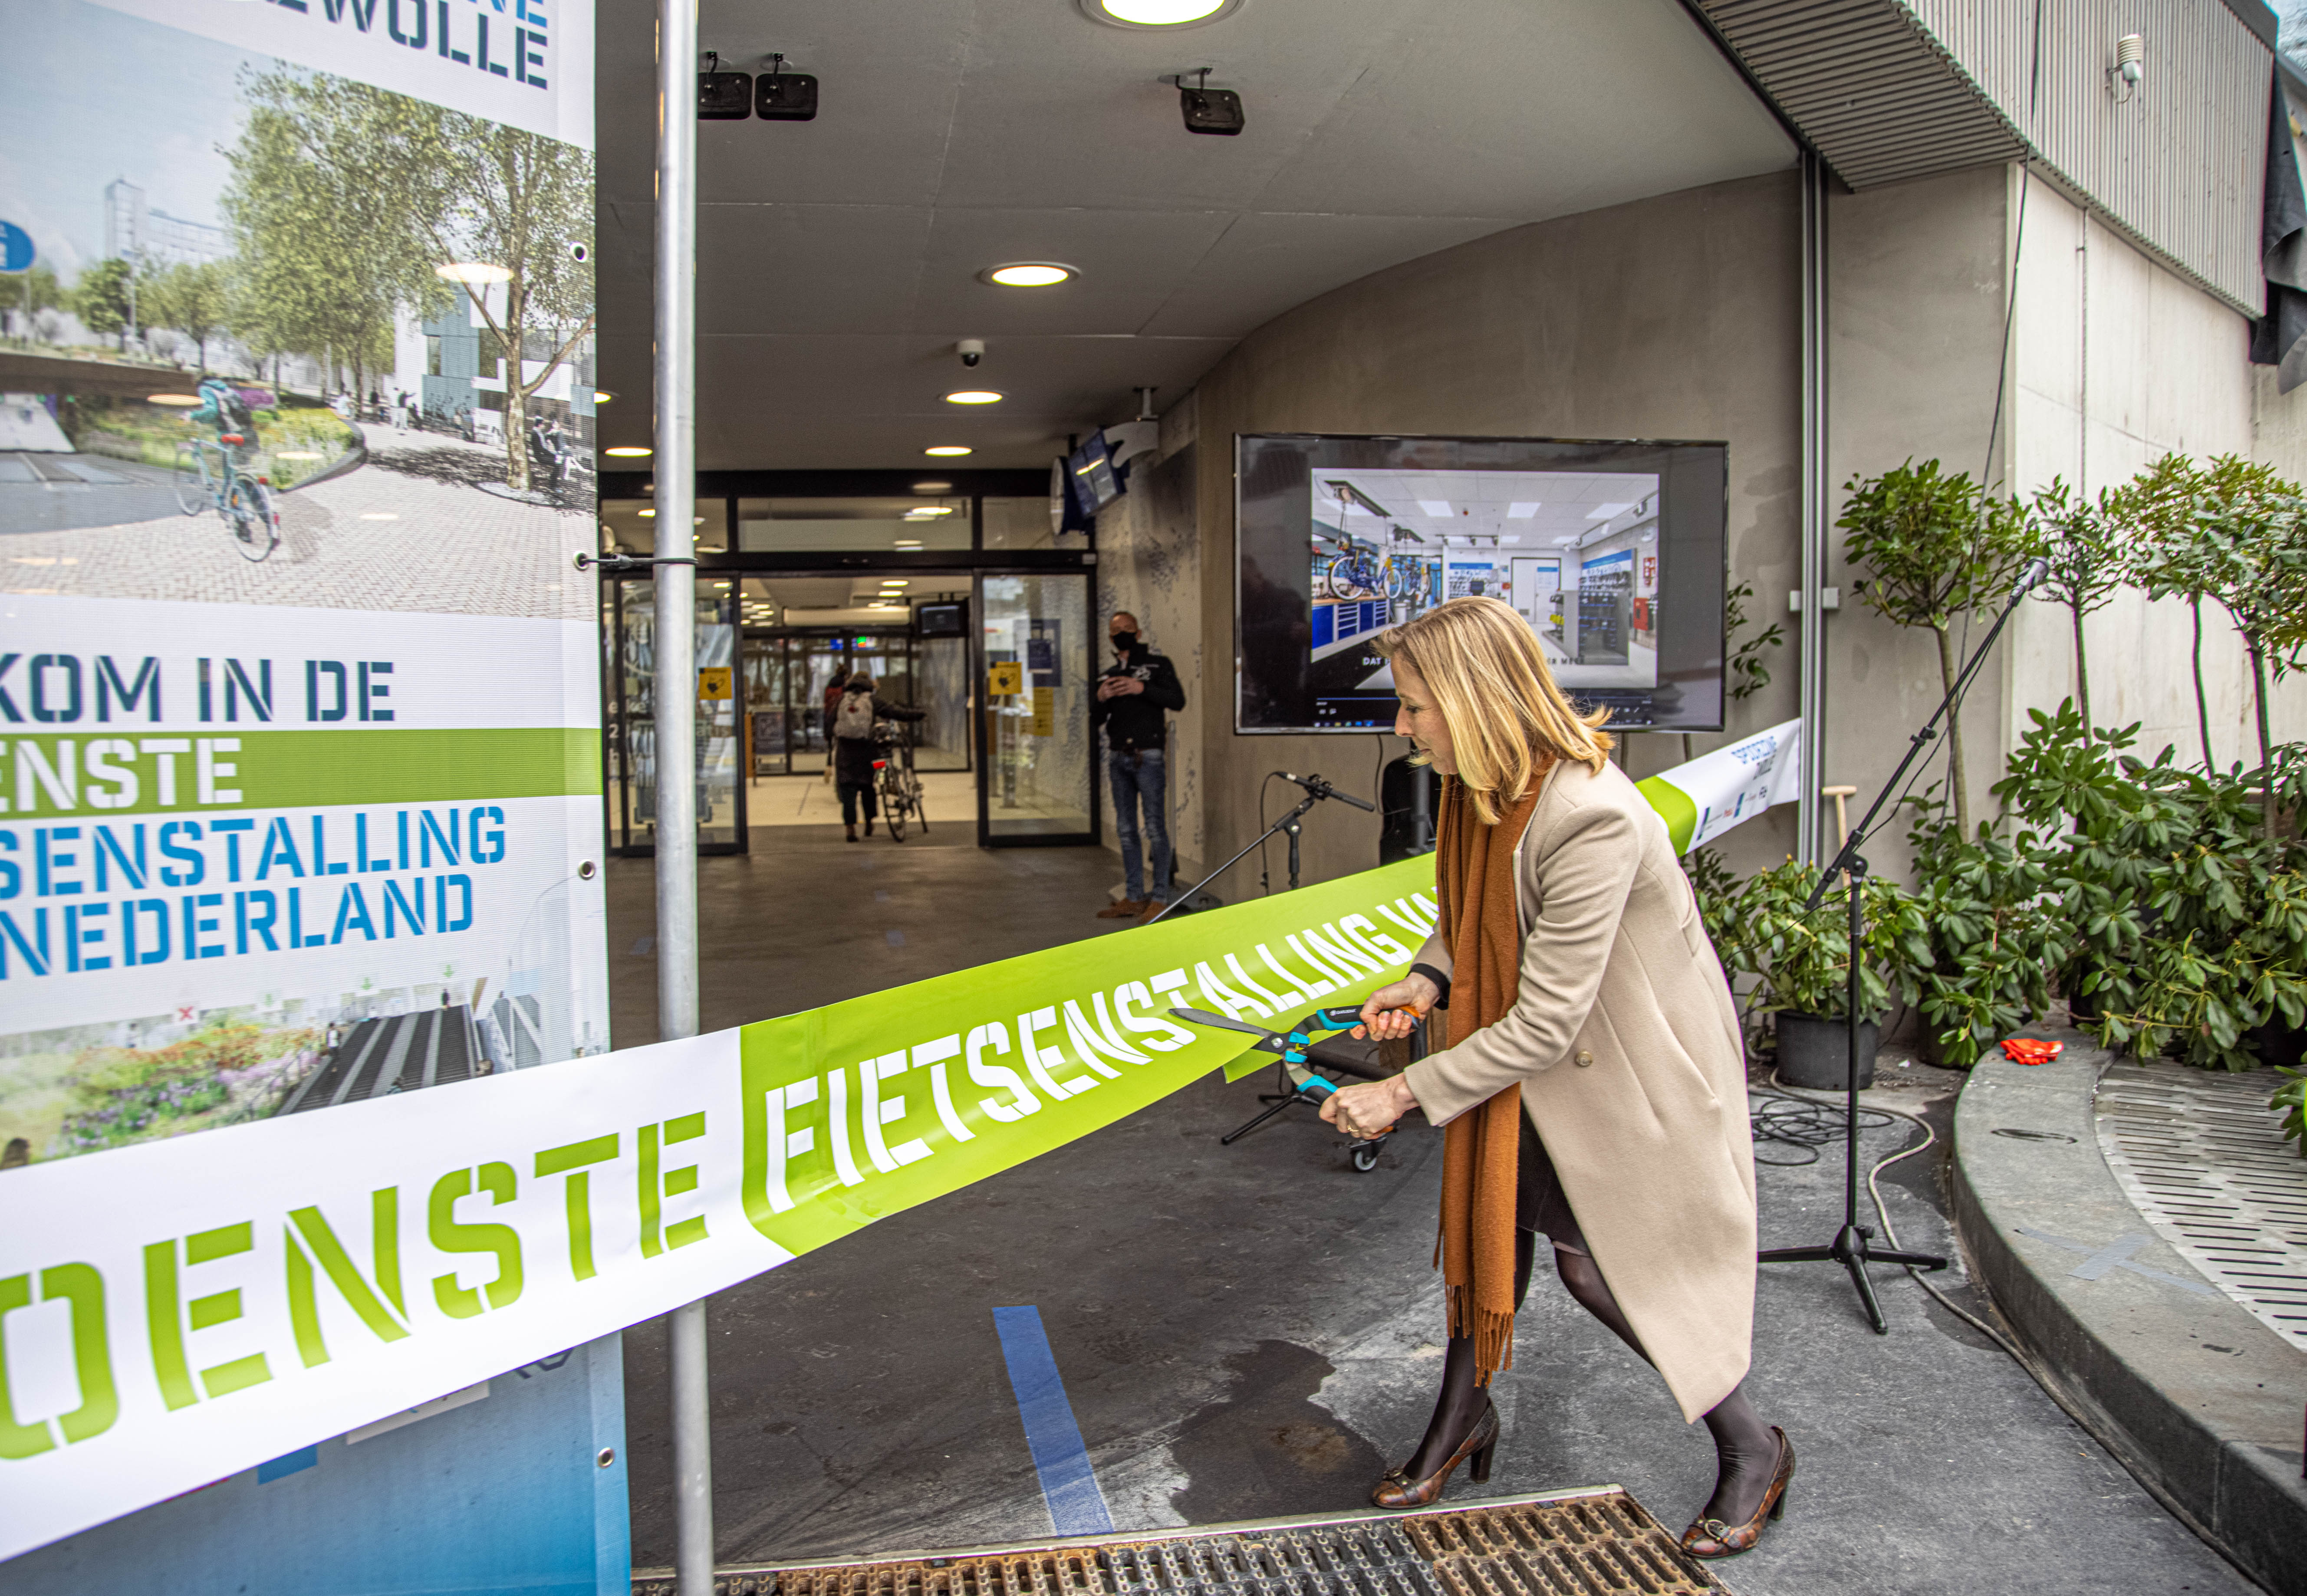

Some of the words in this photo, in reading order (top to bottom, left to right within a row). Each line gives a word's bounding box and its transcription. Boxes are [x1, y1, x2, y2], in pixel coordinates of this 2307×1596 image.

[266, 0, 548, 90] WOLLE
[197, 657, 273, 722] IN
[305, 660, 394, 722] DE
[0, 738, 243, 812] NSTE
[0, 873, 473, 980] NEDERLAND
[0, 1111, 709, 1460] OENSTE
[766, 913, 1413, 1213] FIETSENSTALLING
